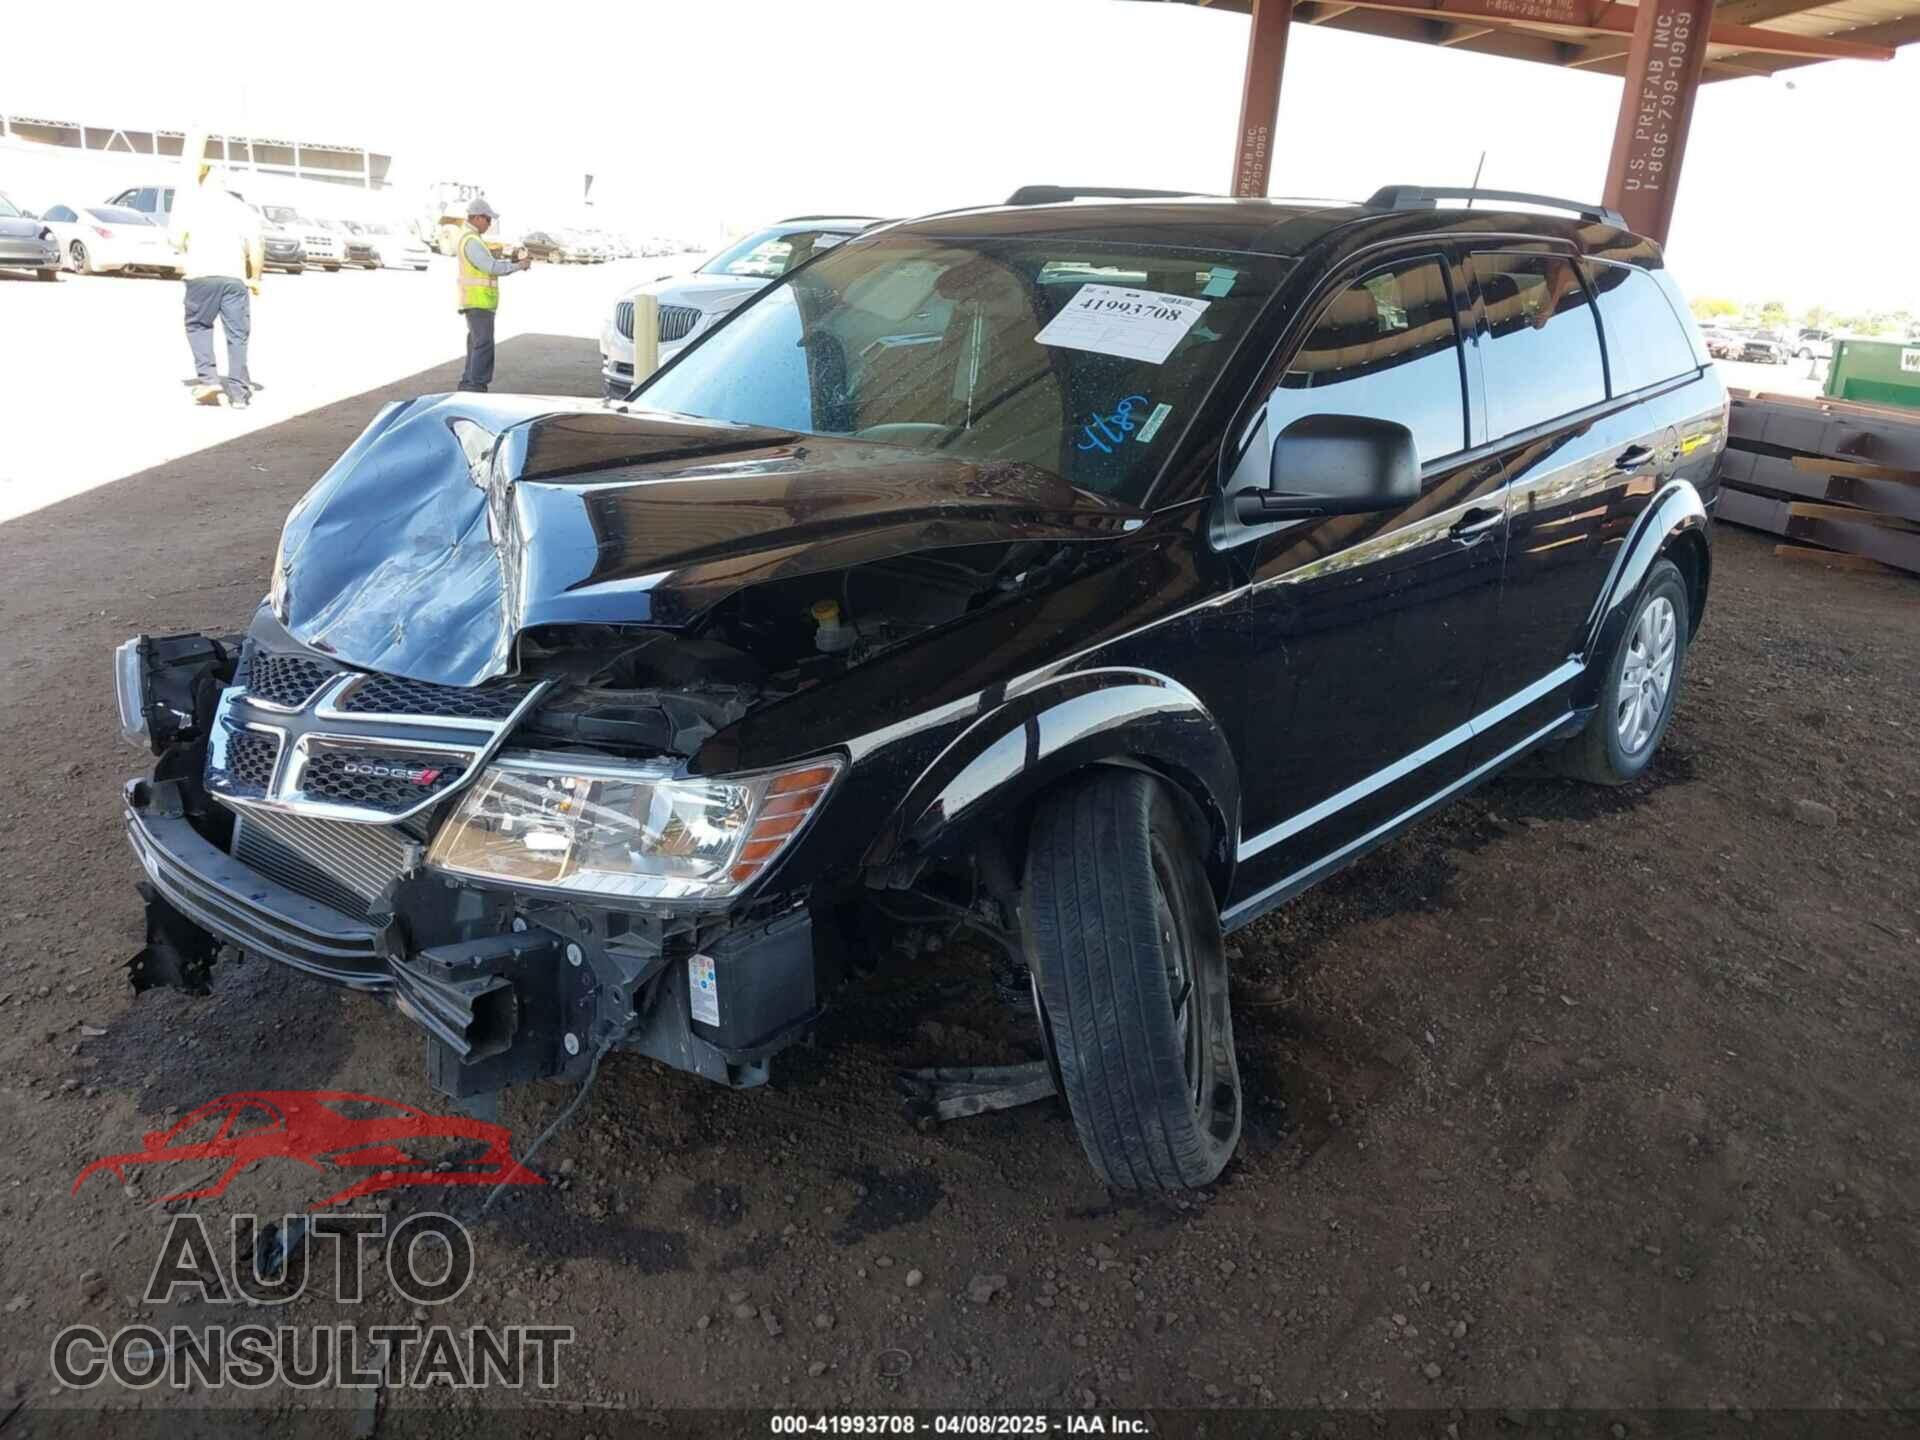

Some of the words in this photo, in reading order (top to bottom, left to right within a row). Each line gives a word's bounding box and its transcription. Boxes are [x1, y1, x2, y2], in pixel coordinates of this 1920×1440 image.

[1625, 153, 1647, 190] U.S.
[1636, 59, 1665, 140] PREFAB
[1653, 8, 1675, 48] INC.
[1643, 12, 1691, 190] 1-866-799-0969
[1080, 298, 1182, 321] 41993708
[344, 763, 423, 780] DODGE
